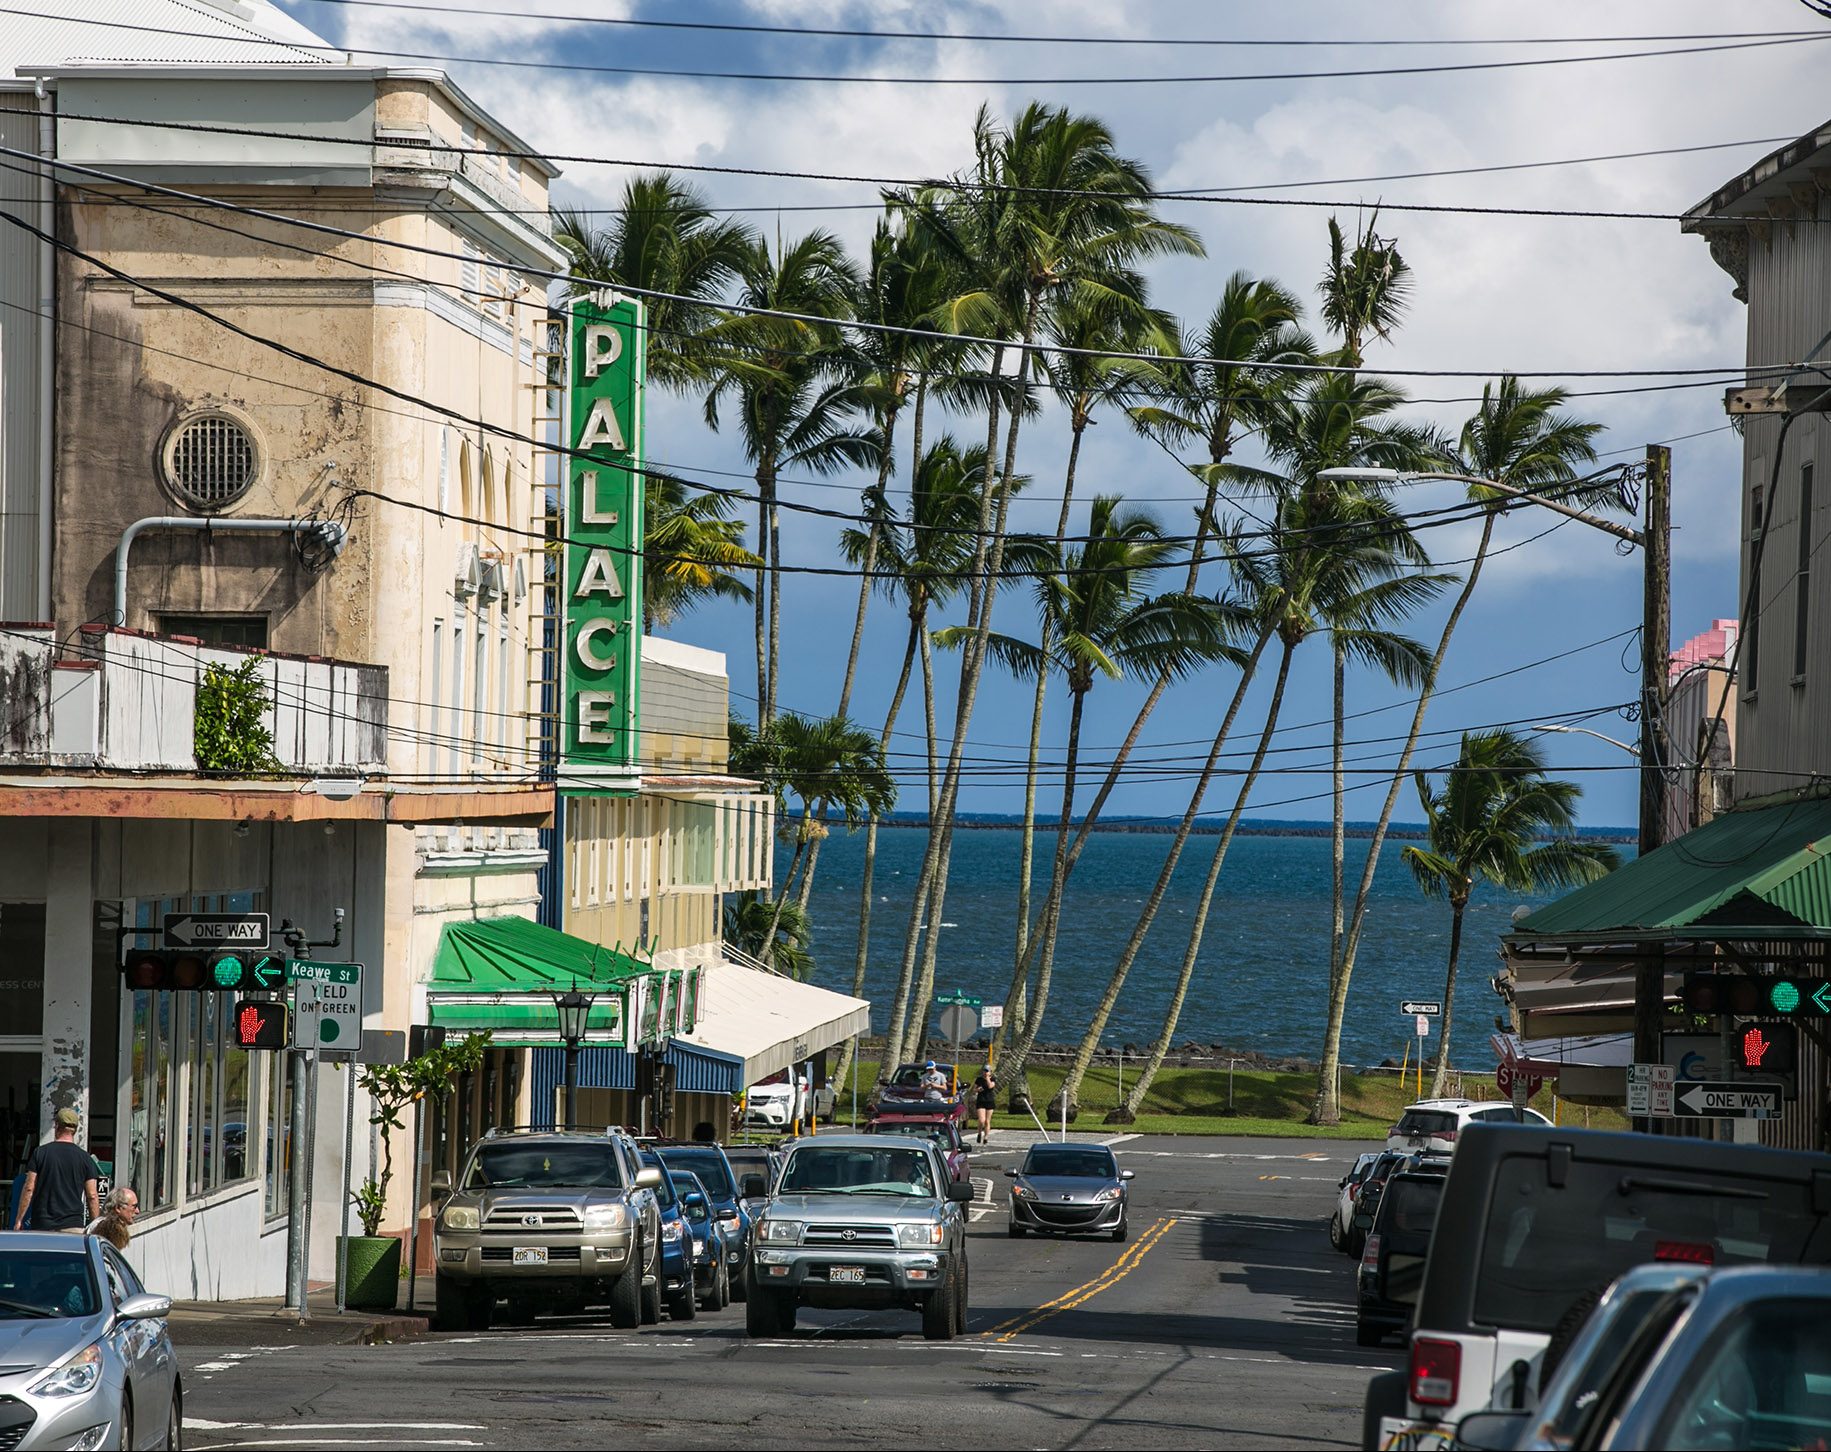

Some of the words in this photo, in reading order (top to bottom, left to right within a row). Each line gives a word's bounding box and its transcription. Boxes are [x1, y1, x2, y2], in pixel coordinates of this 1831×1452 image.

[575, 324, 628, 744] PALACE
[195, 924, 223, 937] ONE
[228, 924, 257, 937] WAY
[292, 962, 331, 979] Keawe
[339, 970, 350, 981] St
[312, 985, 347, 999] YELD
[301, 1003, 314, 1013] ON
[322, 1003, 356, 1014] GREEN
[1628, 1067, 1634, 1080] 2
[1658, 1070, 1667, 1079] NO
[1652, 1081, 1673, 1091] PARKING
[1706, 1093, 1735, 1107] ONE
[1740, 1094, 1771, 1108] WAY
[850, 1270, 864, 1280] 165
